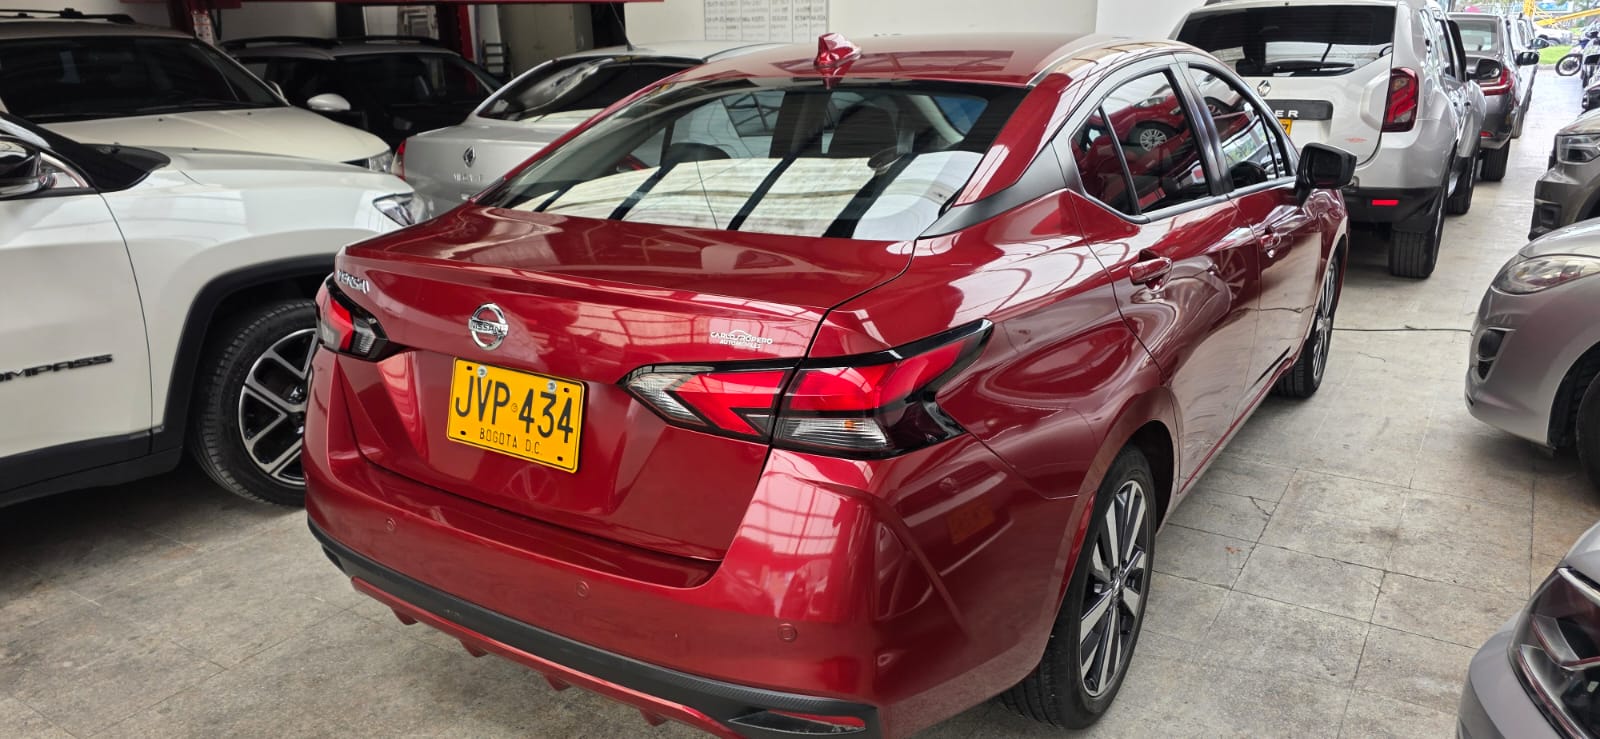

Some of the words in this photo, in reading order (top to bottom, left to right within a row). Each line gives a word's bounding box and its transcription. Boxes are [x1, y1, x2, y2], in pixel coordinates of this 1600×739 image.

[472, 321, 503, 335] NISSAN
[0, 353, 113, 382] MPASS
[455, 375, 511, 425] JVP
[518, 388, 574, 444] 434
[479, 427, 518, 449] BOGOTA
